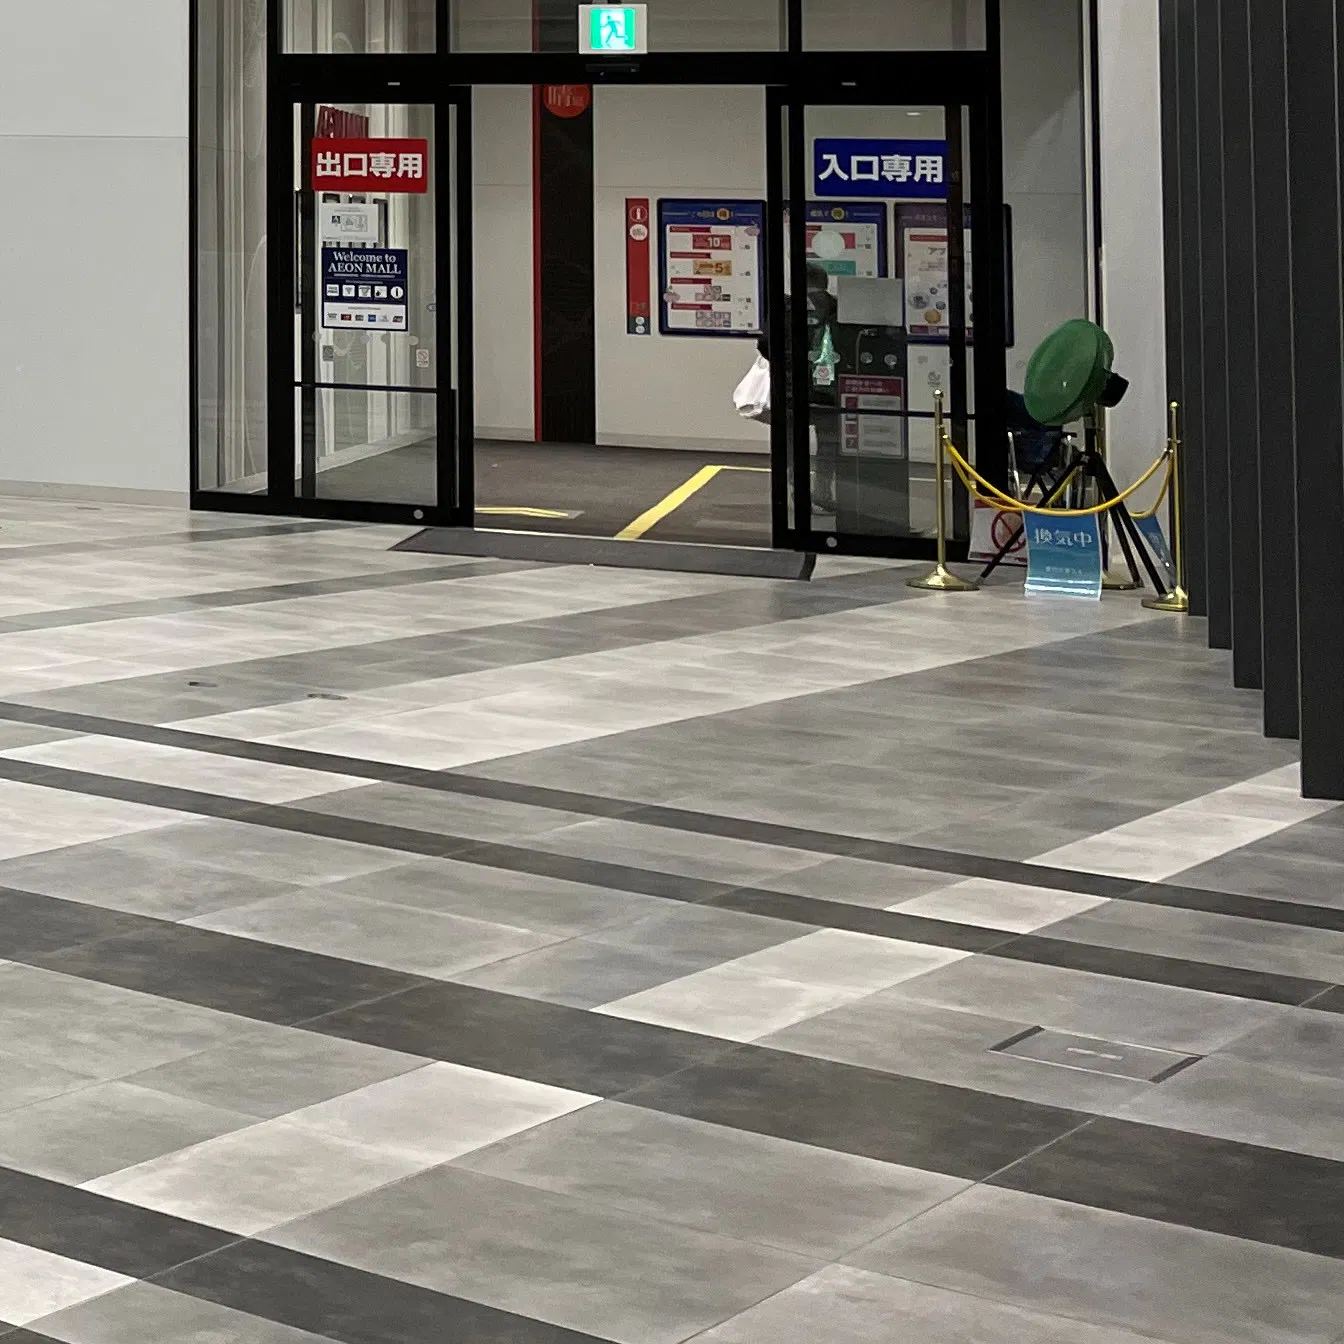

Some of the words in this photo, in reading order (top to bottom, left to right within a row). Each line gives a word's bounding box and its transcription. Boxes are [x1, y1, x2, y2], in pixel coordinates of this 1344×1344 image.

[316, 151, 422, 179] 出口専用
[818, 154, 943, 183] 入口専用
[333, 251, 383, 263] Welcome
[385, 253, 396, 263] to
[328, 262, 363, 273] AEON
[366, 263, 401, 274] MALL
[1035, 528, 1092, 548] 換気中
